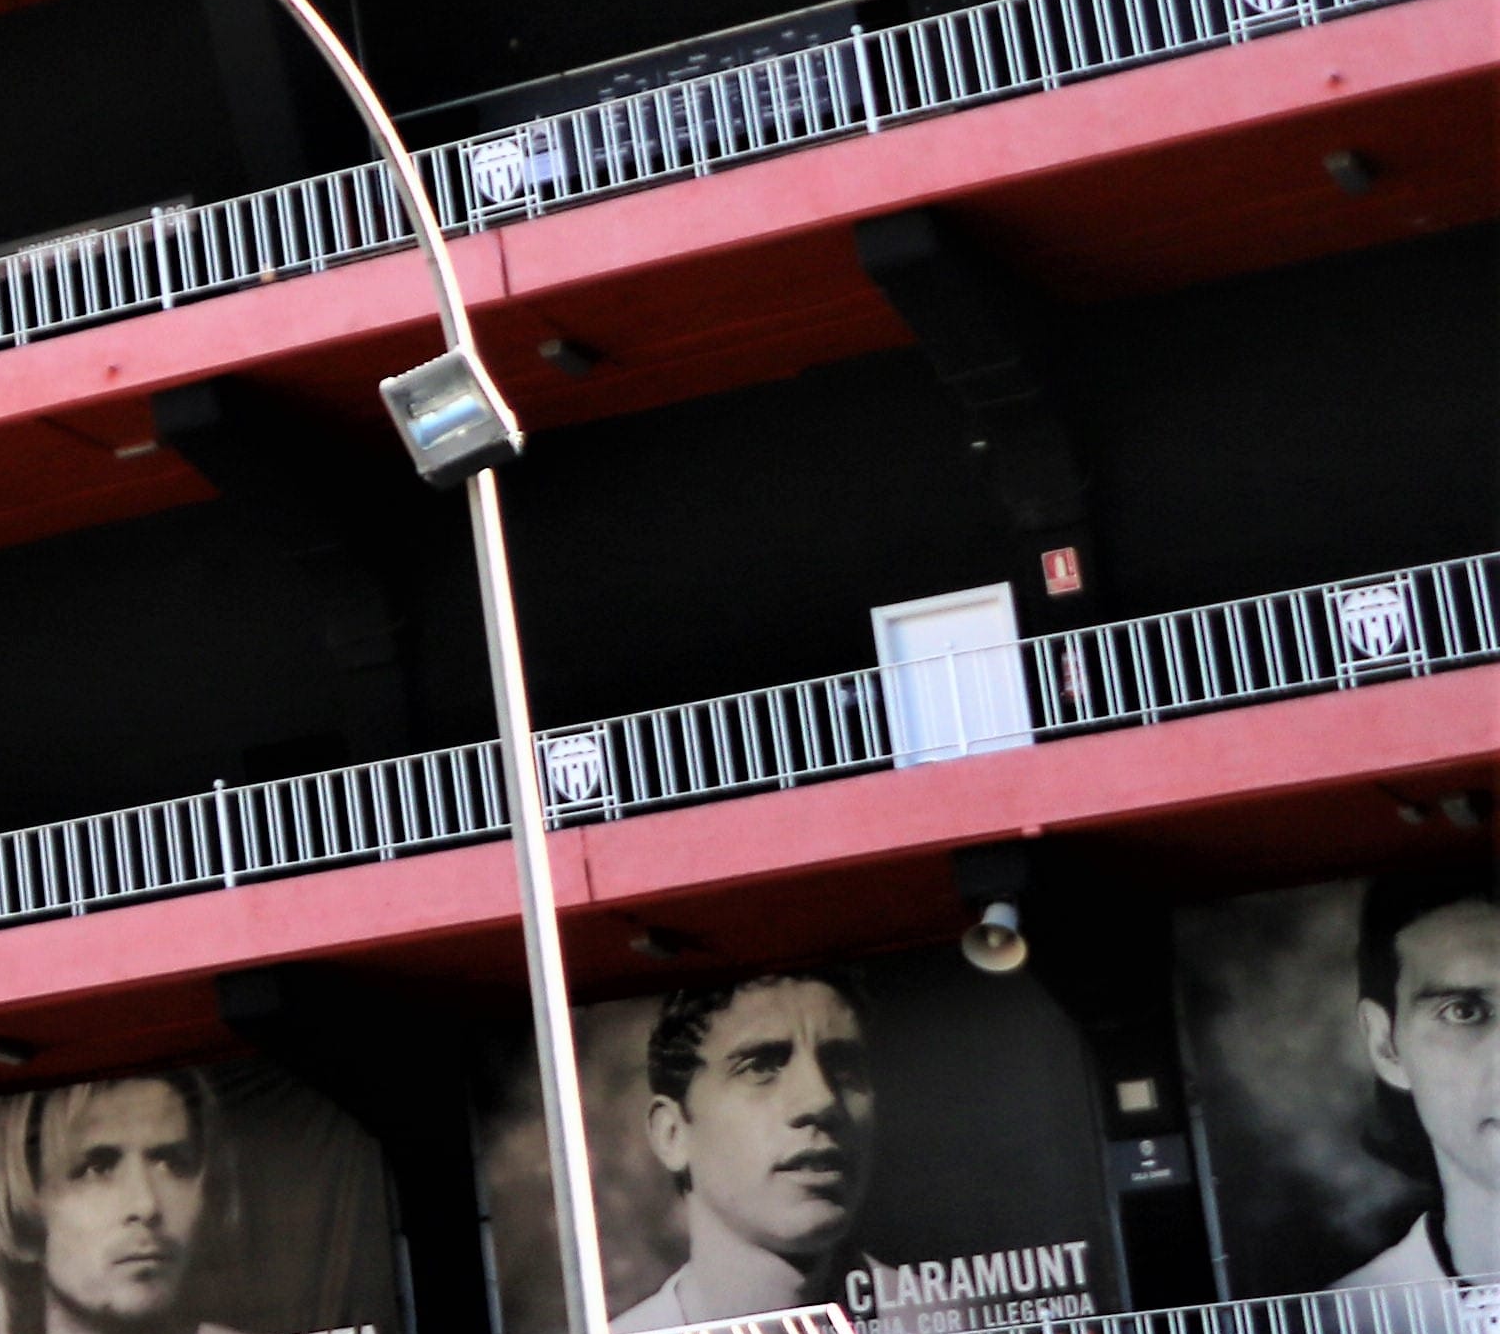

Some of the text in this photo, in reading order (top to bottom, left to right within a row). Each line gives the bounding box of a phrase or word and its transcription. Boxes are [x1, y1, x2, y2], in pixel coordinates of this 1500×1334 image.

[845, 1241, 1088, 1313] CLARAMUNT
[918, 1309, 962, 1334] COR
[983, 1292, 1096, 1328] LLEGENDA
